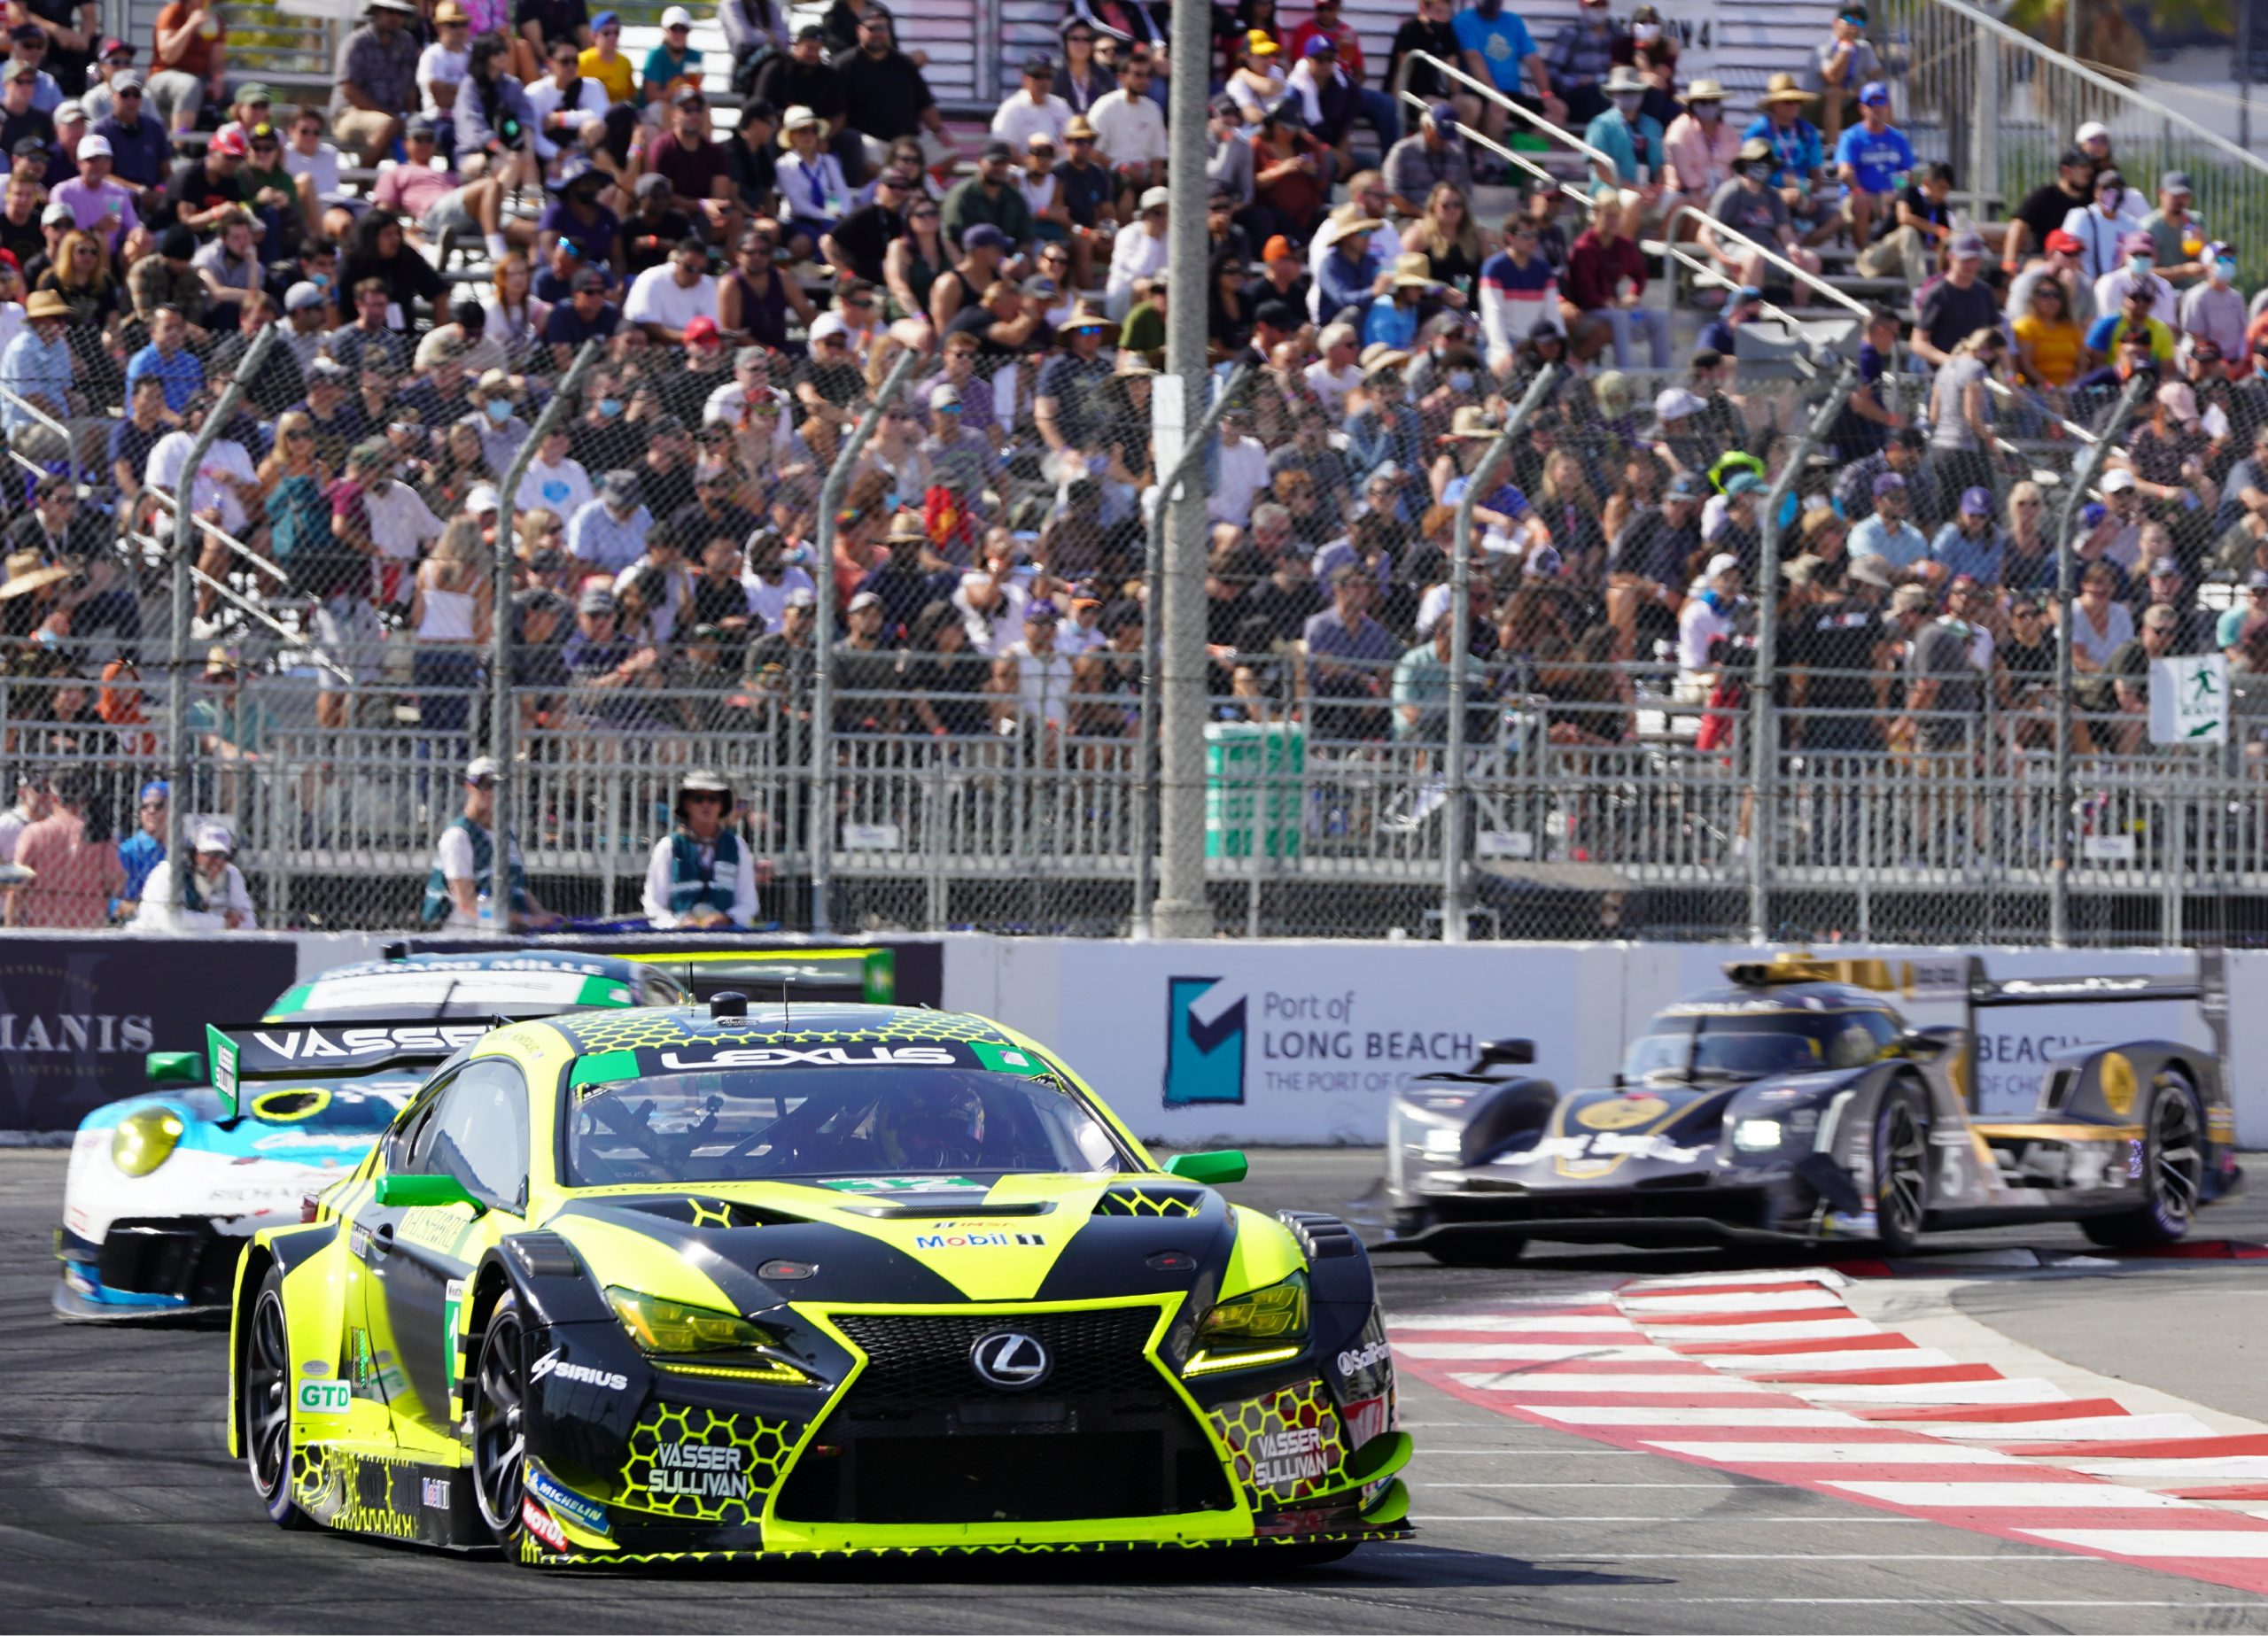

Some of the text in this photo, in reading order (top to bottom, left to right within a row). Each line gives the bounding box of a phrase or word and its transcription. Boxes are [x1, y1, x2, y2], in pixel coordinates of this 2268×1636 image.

[1262, 989, 1355, 1025] Port of
[252, 1025, 498, 1060] VASSE
[661, 1046, 957, 1070] LEXUS
[1263, 1030, 1474, 1060] LONG BEACH
[1264, 1071, 1304, 1091] THE
[1307, 1071, 1358, 1092] PORT
[1363, 1071, 1394, 1092] OF
[1940, 1145, 1964, 1197] 5
[916, 1232, 1009, 1249] Mobil
[554, 1361, 628, 1391] SIRIUS
[301, 1384, 349, 1407] GTD
[657, 1441, 742, 1471] VASSER
[1257, 1427, 1321, 1460] VASSER
[648, 1469, 748, 1500] SULLIVAN
[1254, 1452, 1329, 1486] SULLIVAN
[538, 1482, 603, 1522] MICHELIN
[523, 1502, 566, 1547] MOTUL
